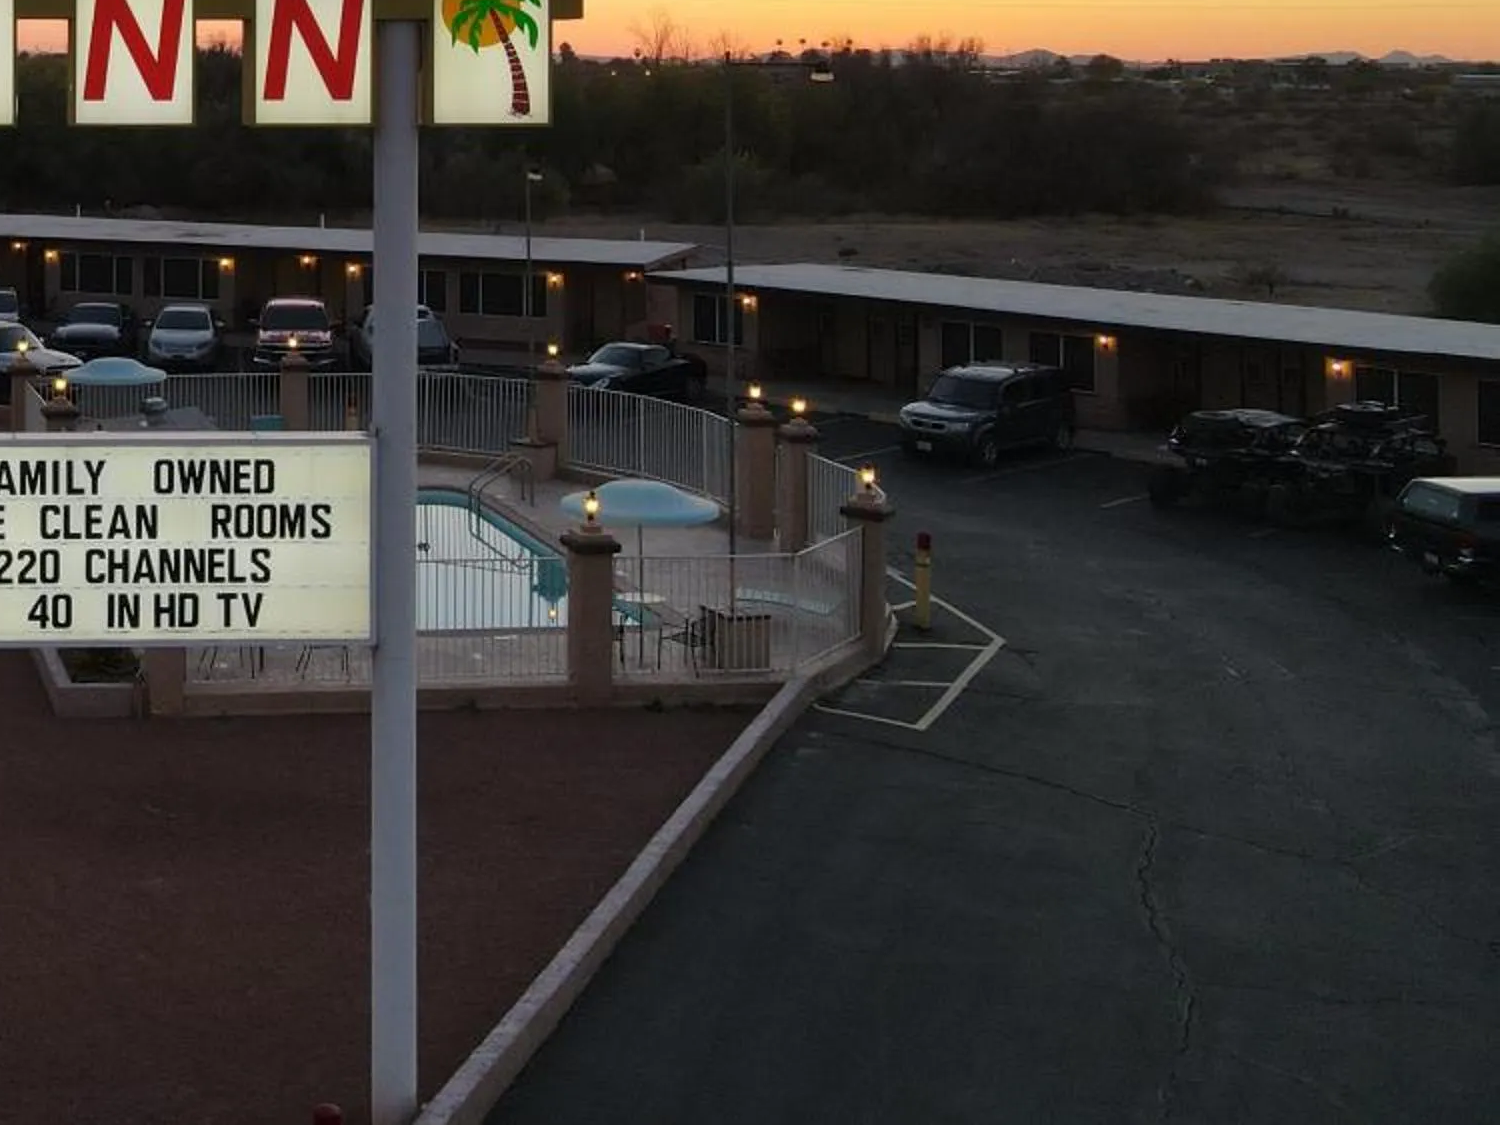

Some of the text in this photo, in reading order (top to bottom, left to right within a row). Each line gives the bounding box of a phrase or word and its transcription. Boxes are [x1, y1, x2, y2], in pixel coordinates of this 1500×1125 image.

[153, 459, 276, 495] OWNED
[39, 504, 158, 540] CLEAN
[211, 503, 332, 540] ROOMS
[85, 548, 271, 584] CHANNELS
[27, 592, 263, 630] 40 IN HD TV
